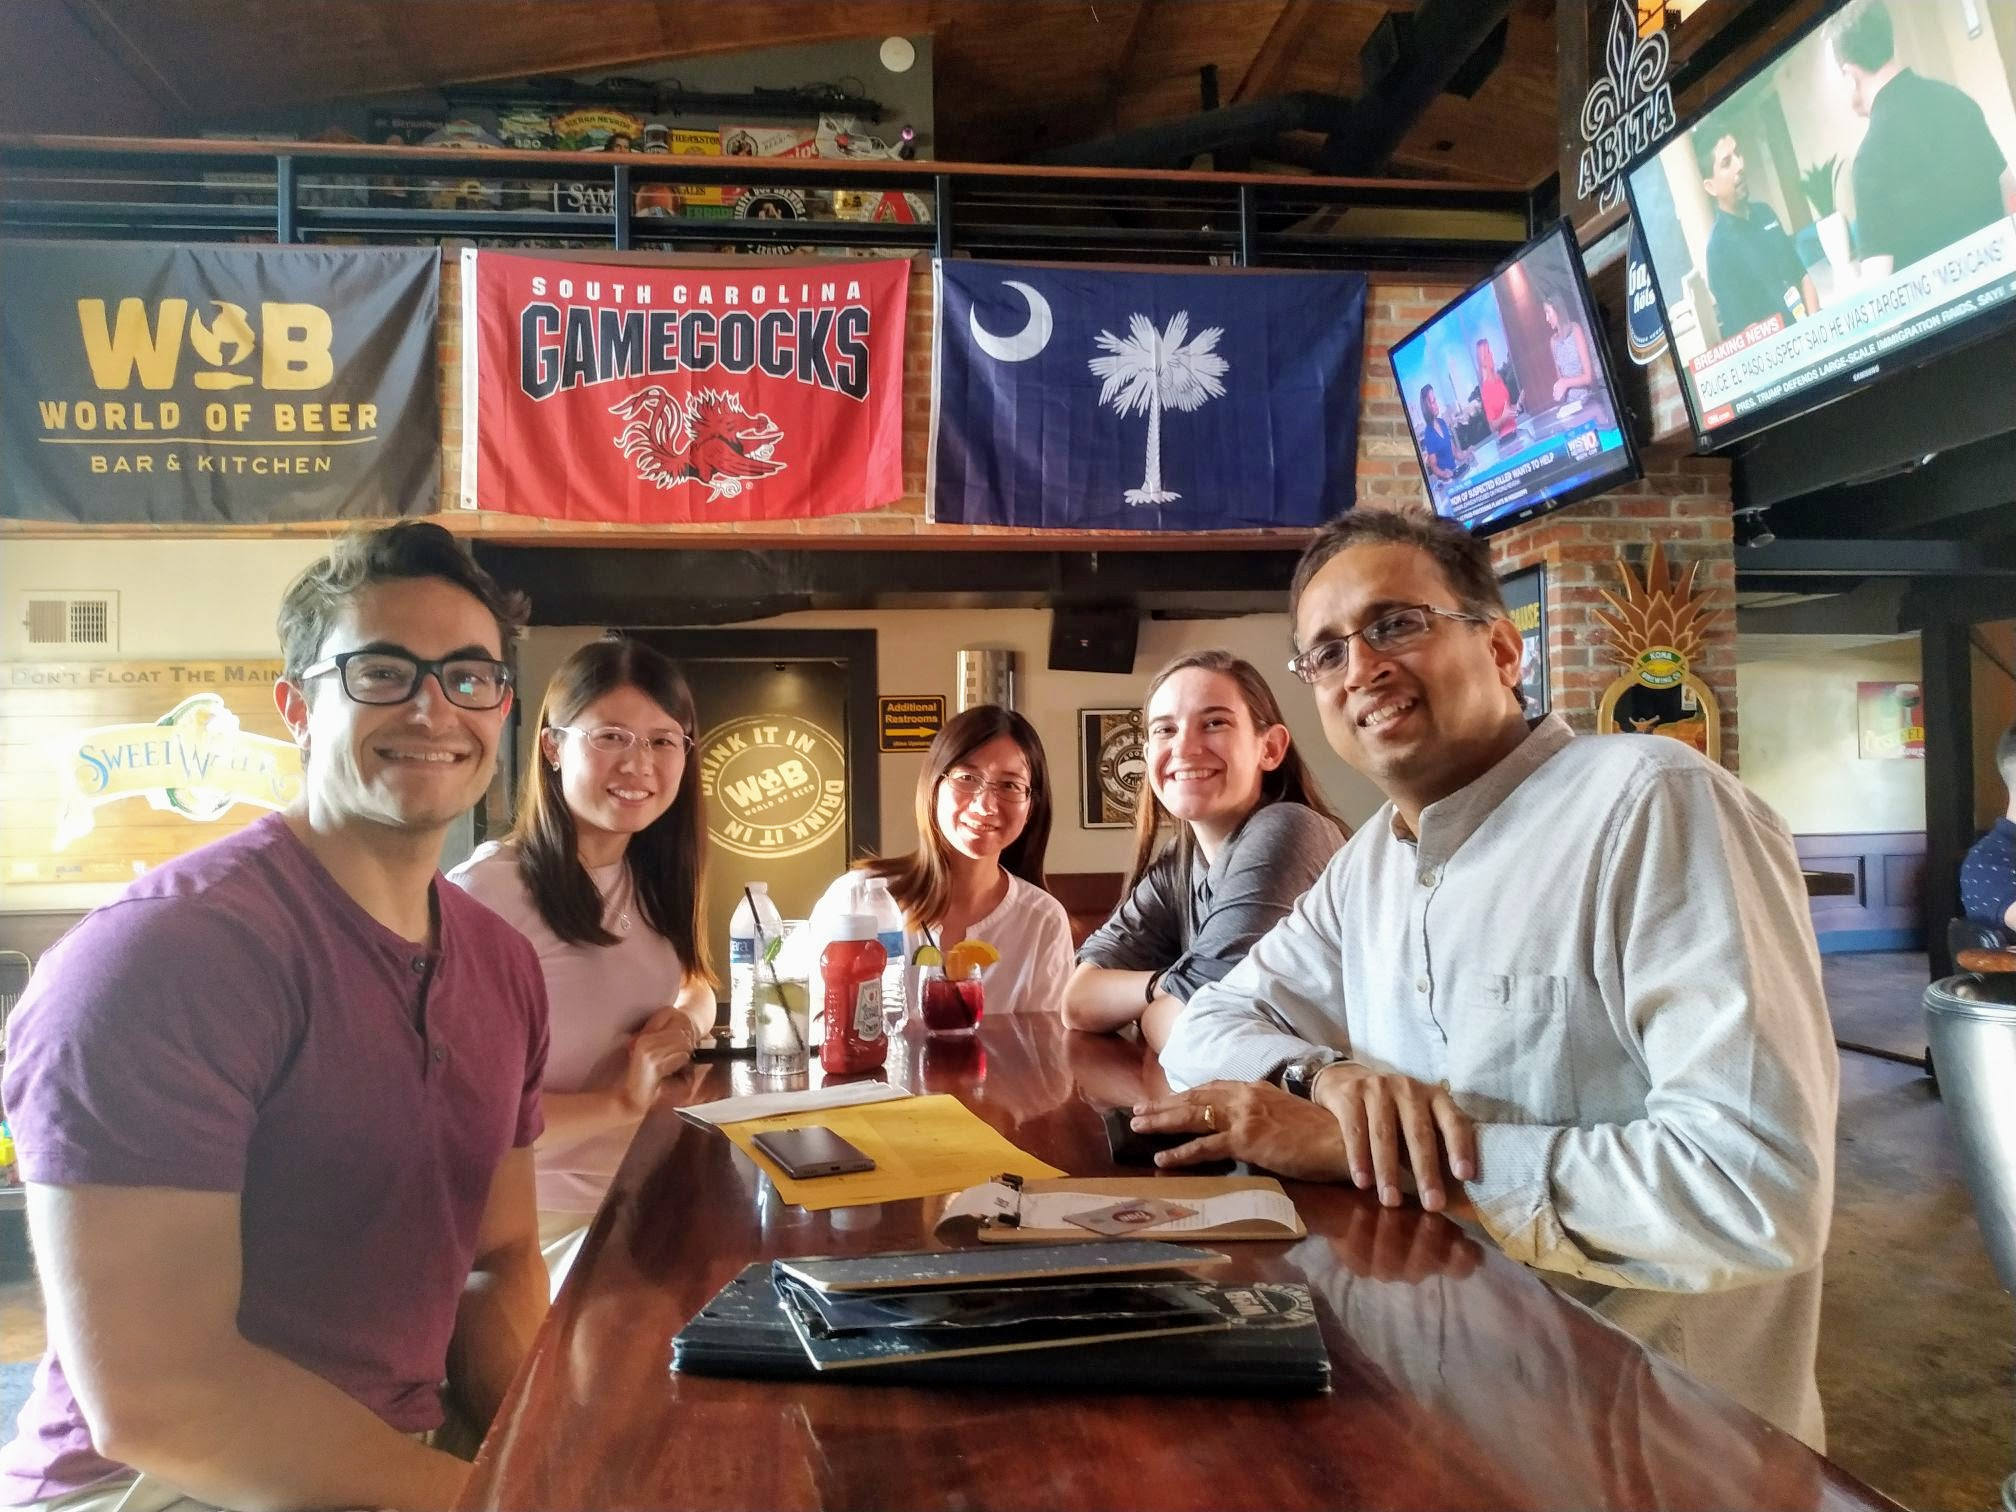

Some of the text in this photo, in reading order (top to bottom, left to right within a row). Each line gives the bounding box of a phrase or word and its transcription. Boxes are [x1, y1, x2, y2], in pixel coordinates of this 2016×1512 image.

[1577, 81, 1676, 200] ABITA
[568, 183, 615, 207] SAM
[532, 276, 861, 304] SOUTH CAROLINA
[1693, 317, 1780, 371] BREAKING NEWS
[1731, 368, 1742, 386] EL
[1743, 355, 1765, 379] PASO
[1765, 336, 1801, 368] SUSPECT
[1805, 325, 1828, 350] SAID
[1830, 317, 1843, 337] HE
[1846, 304, 1869, 331] WAS
[1869, 275, 1932, 320] TARGETING
[520, 301, 871, 403] GAMECOCKS
[1756, 386, 1782, 403] TRUMP
[1782, 370, 1819, 392] DEFENDS
[1818, 343, 1877, 377] LARGE-SCALE
[1877, 315, 1941, 351] IMMIGRATION
[38, 400, 377, 432] WORLD OF BEER
[91, 453, 332, 474] BAR & KITCHEN
[89, 667, 161, 684] FLOAT
[169, 666, 216, 683] THE
[224, 666, 284, 683] MAIN
[886, 714, 938, 724] Restrooms
[888, 702, 937, 712] Additional
[753, 726, 779, 745] IT
[786, 729, 816, 754] IN
[744, 784, 816, 816] WORLD OF BEER
